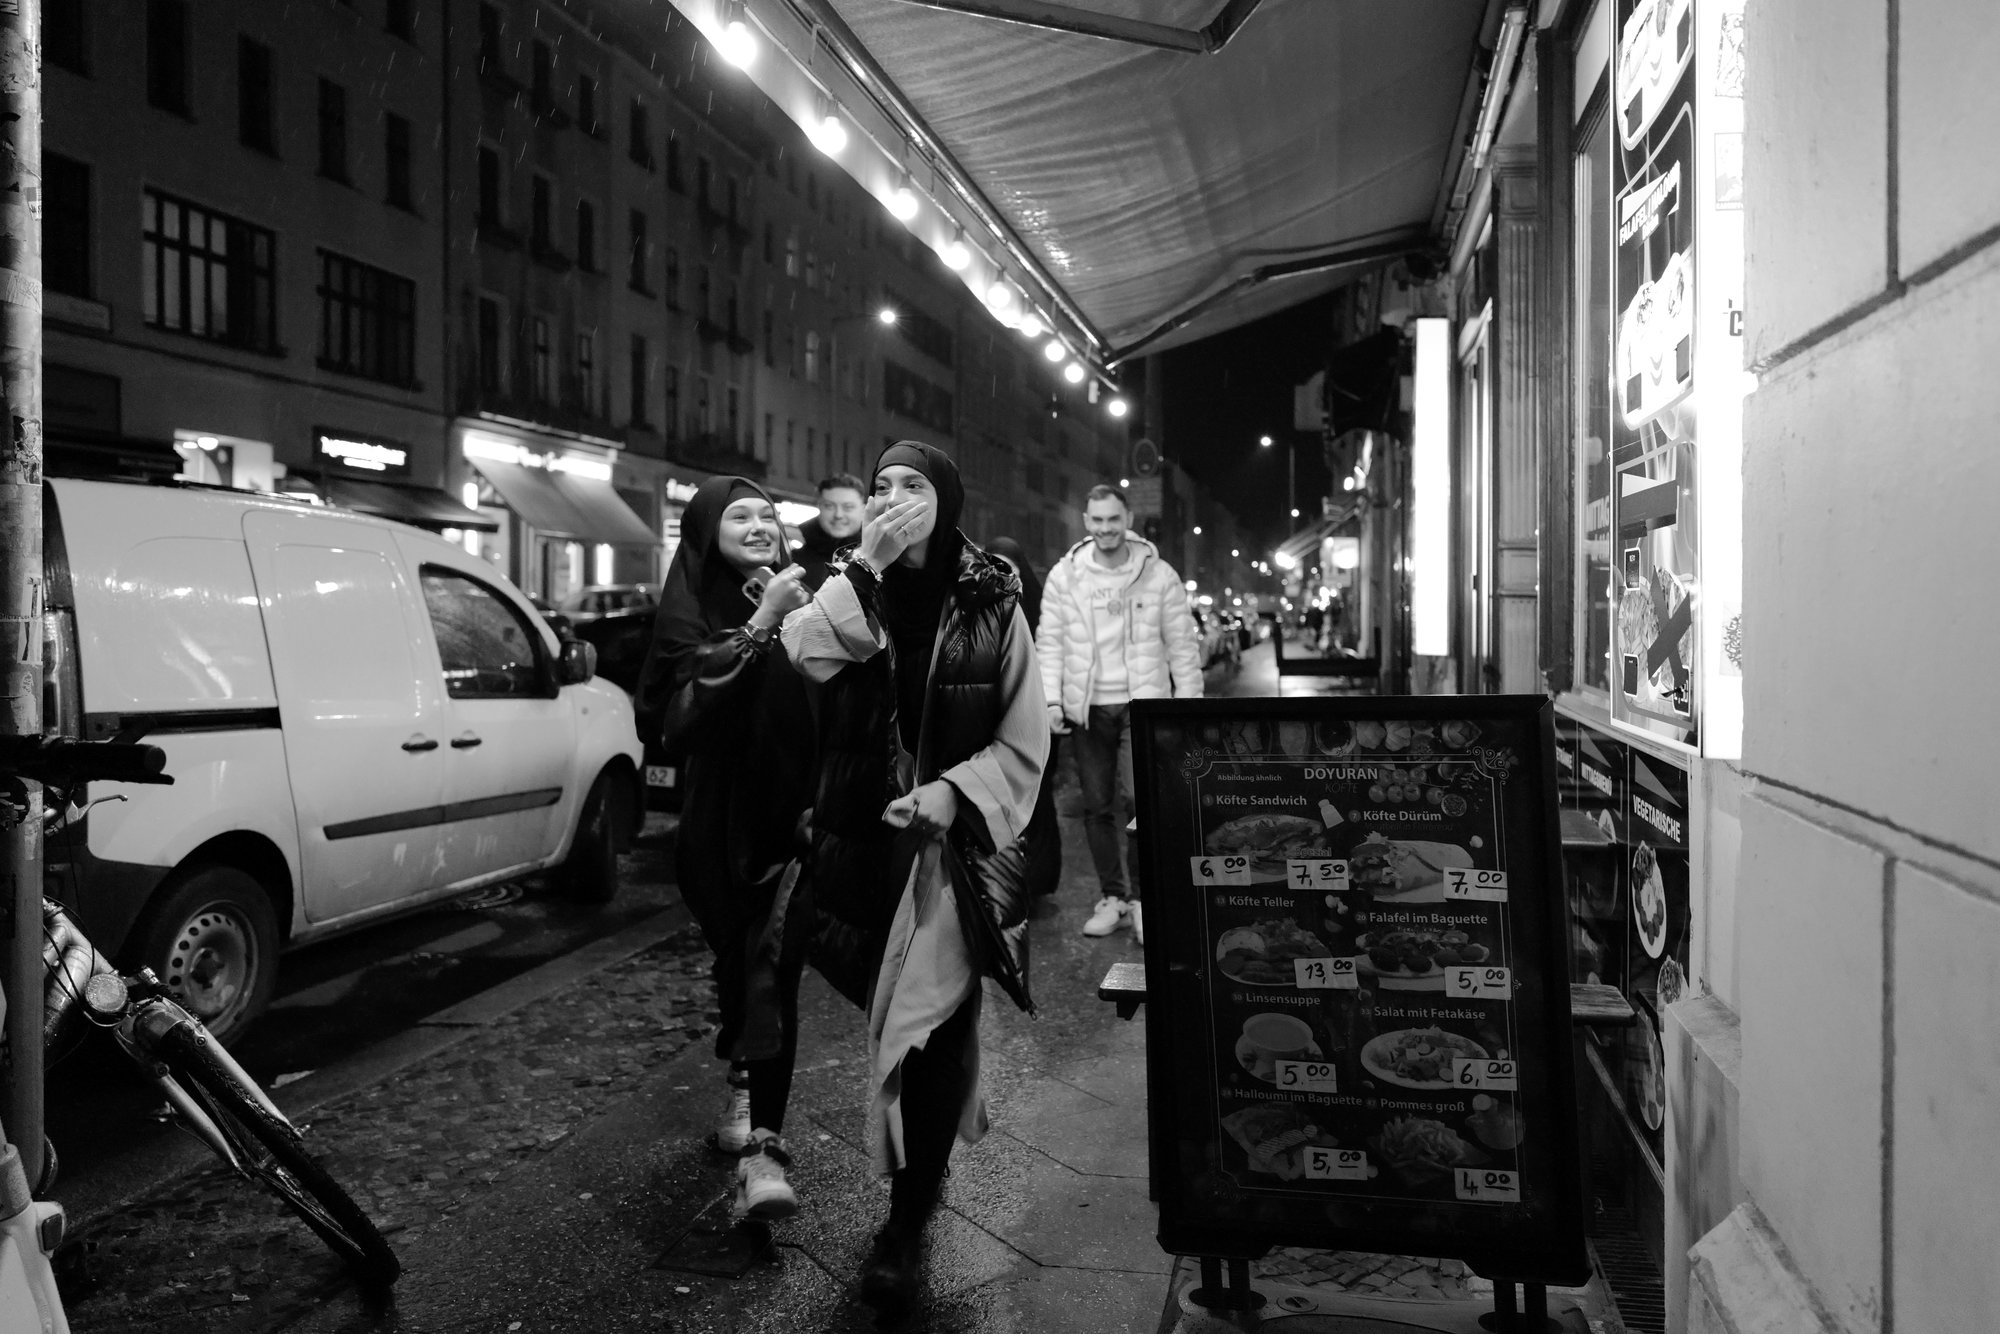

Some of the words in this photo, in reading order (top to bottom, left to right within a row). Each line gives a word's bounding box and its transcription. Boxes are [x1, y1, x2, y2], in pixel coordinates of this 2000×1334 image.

[1217, 773, 1255, 783] Abbildung
[1255, 773, 1282, 782] ähnlich
[1303, 767, 1379, 781] DOYURAN
[1216, 795, 1248, 806] Köfte
[1250, 795, 1308, 806] Sandwich
[1363, 810, 1397, 822] Köfte
[1399, 810, 1442, 822] Dürüm
[1633, 794, 1681, 844] VEGETARISCHE
[1229, 895, 1261, 907] Köfte
[1262, 896, 1295, 908] Teller
[1369, 912, 1410, 923] Falafel
[1413, 913, 1428, 923] im
[1431, 914, 1488, 926] Baguette
[1246, 992, 1321, 1007] Linsensuppe
[1374, 1006, 1405, 1018] Salat
[1407, 1007, 1428, 1018] mit
[1431, 1008, 1486, 1020] Fetakäse
[1234, 1088, 1287, 1101] Halloumi
[1290, 1091, 1305, 1103] im
[1308, 1093, 1363, 1107] Baguette
[1380, 1098, 1433, 1111] Pommes
[1435, 1101, 1465, 1114] groß
